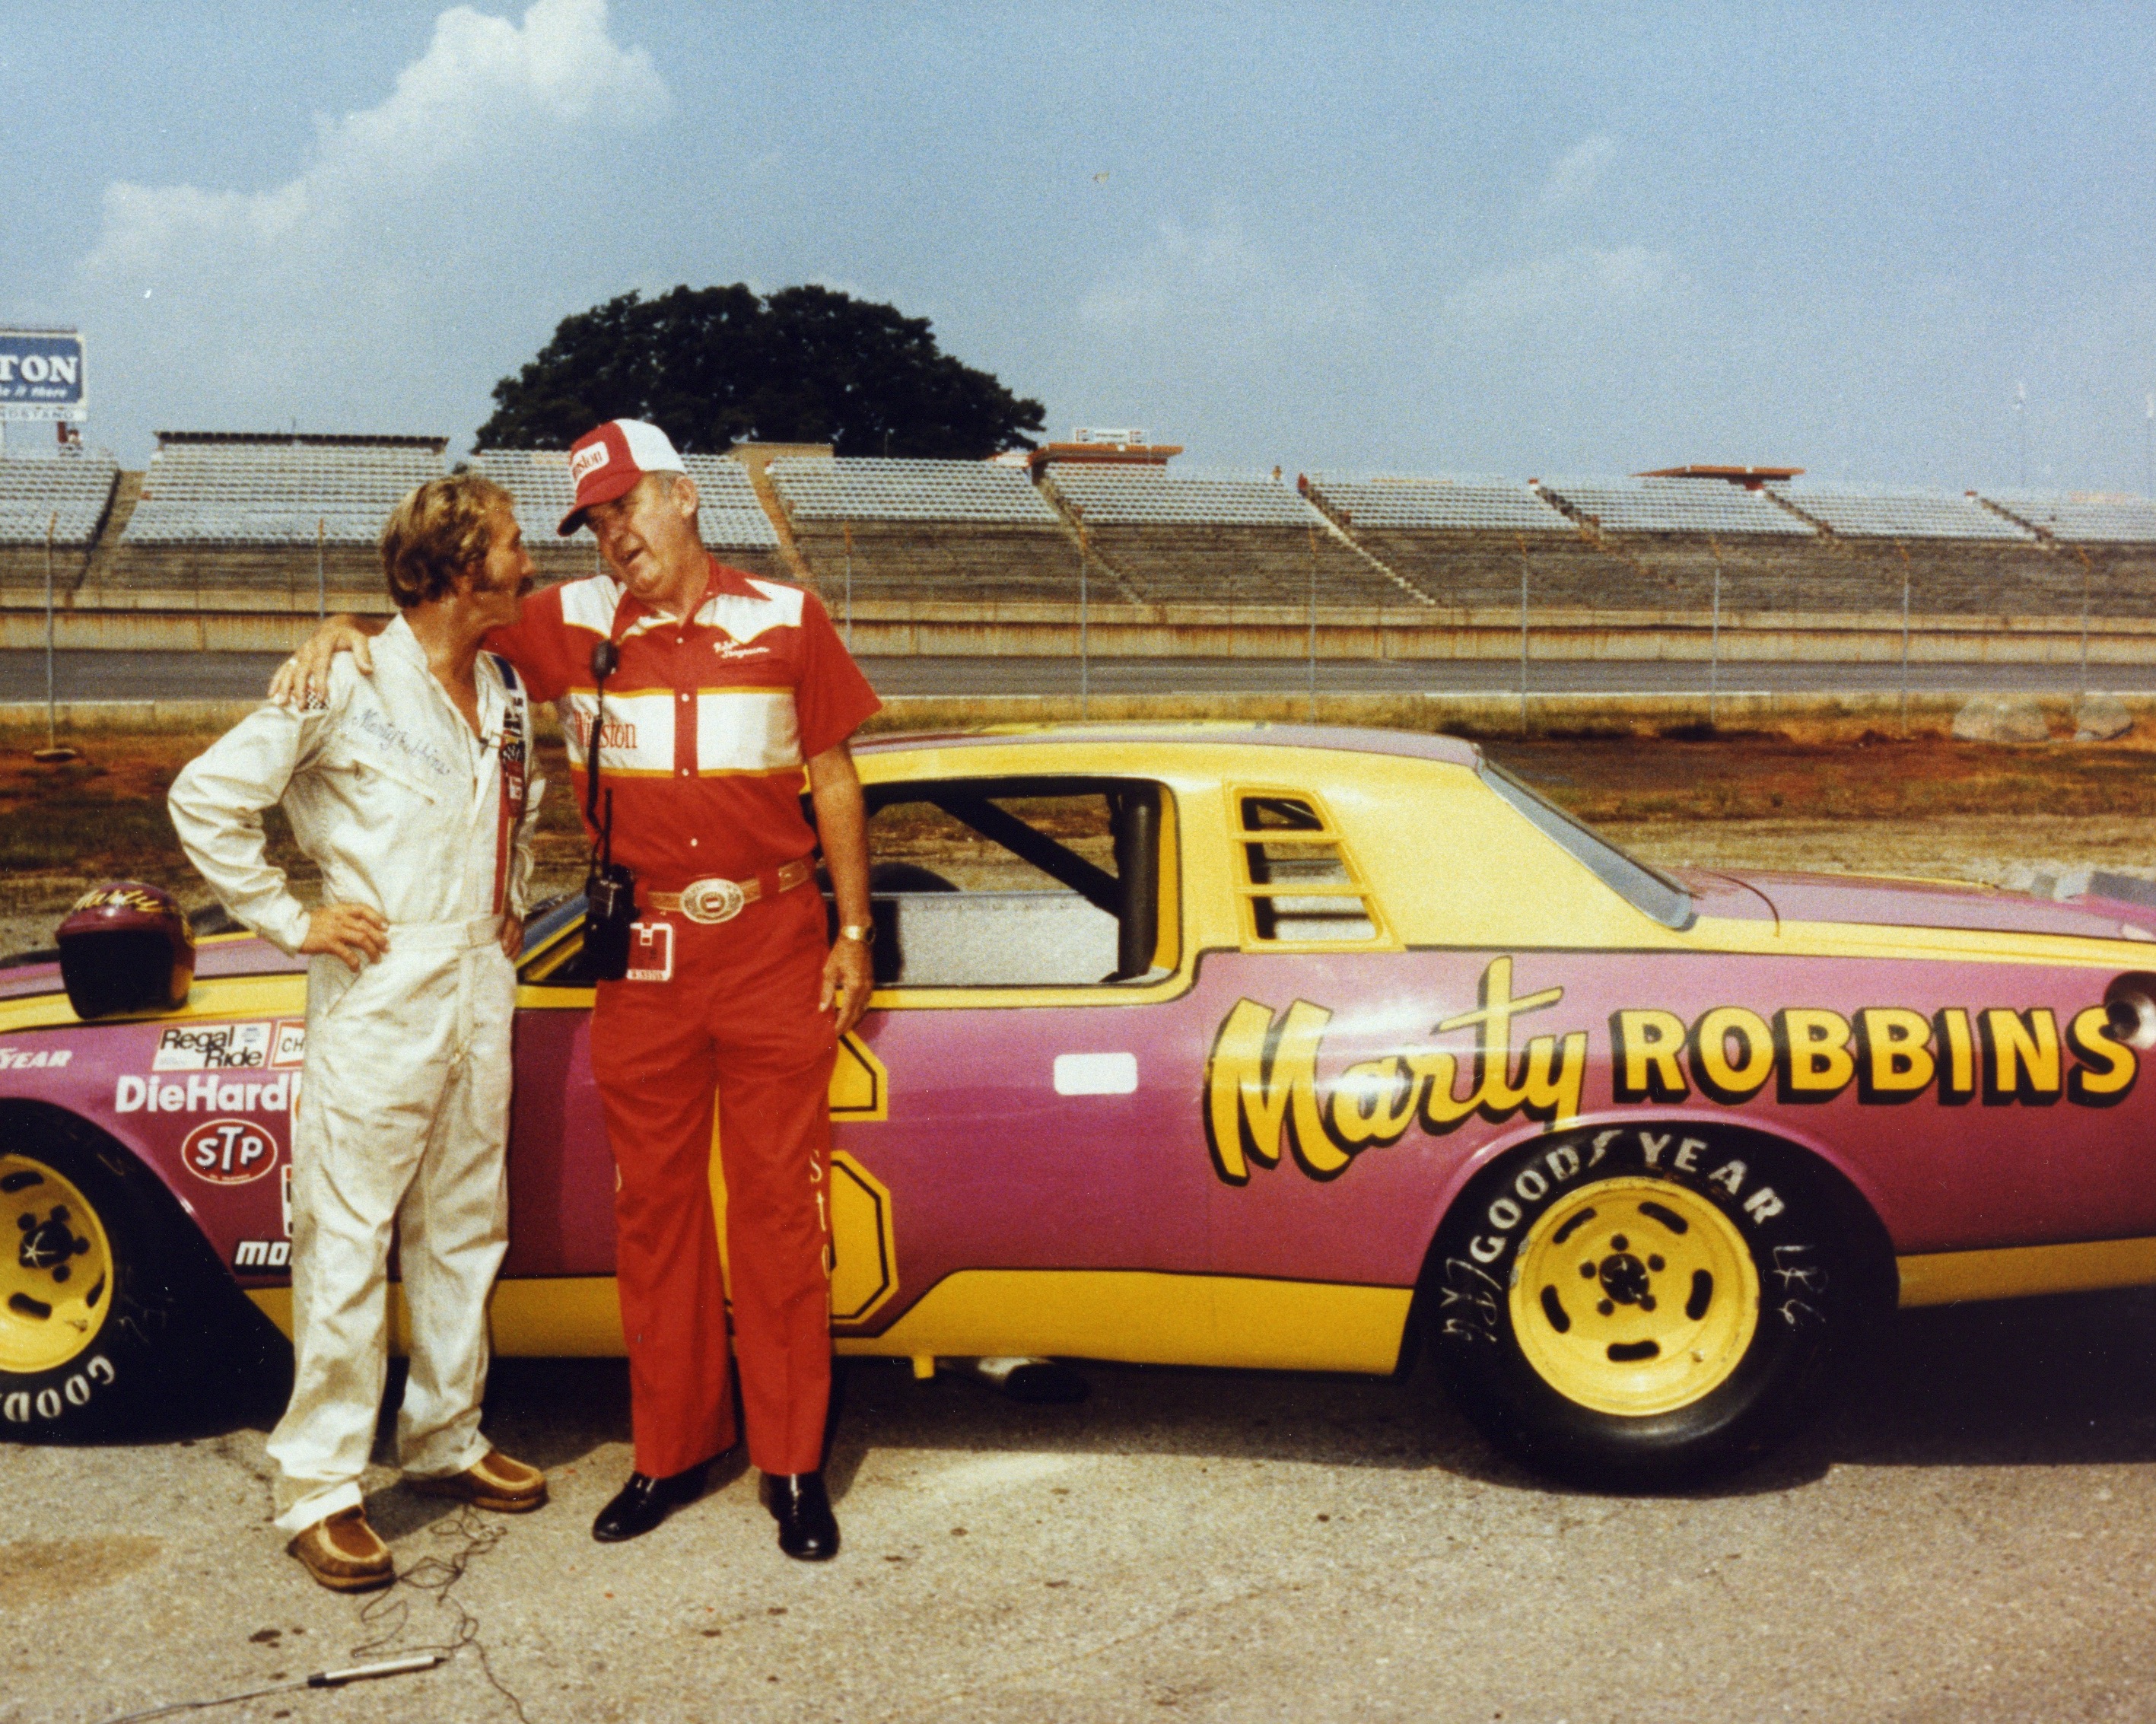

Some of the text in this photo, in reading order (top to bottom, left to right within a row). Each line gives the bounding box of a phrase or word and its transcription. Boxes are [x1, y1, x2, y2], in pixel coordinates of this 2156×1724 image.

[161, 1026, 236, 1054] Regal
[204, 1047, 262, 1068] Ride
[1202, 955, 2138, 1185] Marty ROBBINS
[116, 1072, 291, 1113] DieHard
[195, 1127, 262, 1172] STP
